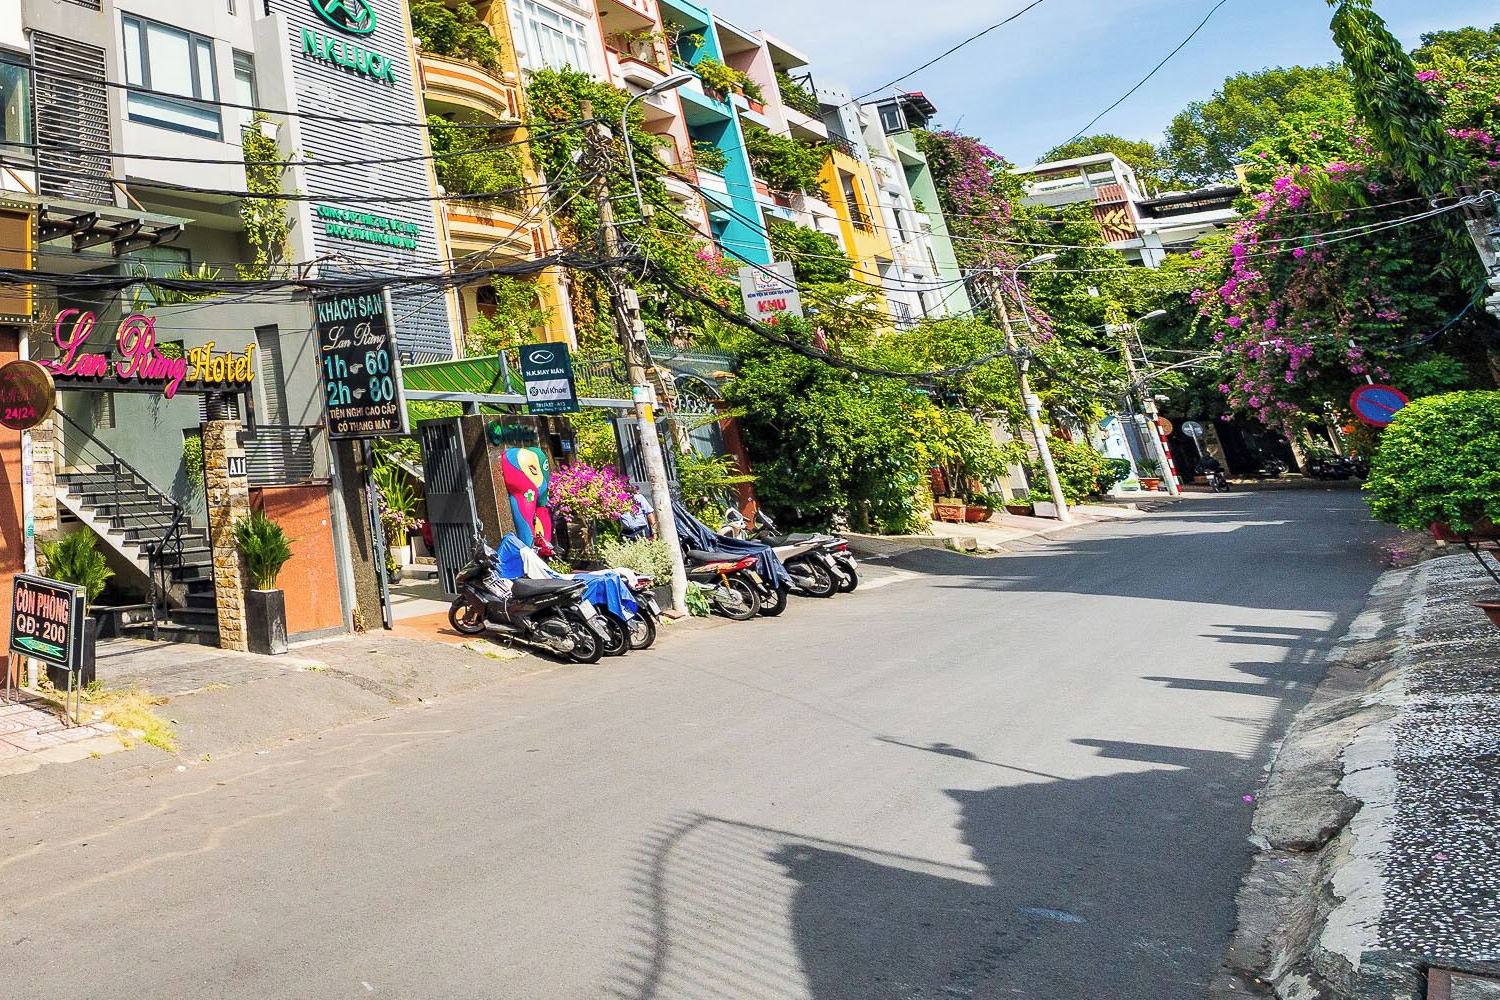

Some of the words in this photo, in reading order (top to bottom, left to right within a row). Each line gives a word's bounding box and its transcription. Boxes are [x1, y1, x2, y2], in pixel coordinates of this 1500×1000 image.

[301, 27, 396, 83] N.K.LUCK
[318, 296, 357, 323] KHÁCH
[358, 293, 383, 320] SẠN
[757, 298, 787, 312] KHU
[323, 326, 351, 351] Lan
[354, 322, 386, 350] Rừng
[40, 308, 107, 377] Lan
[117, 314, 187, 399] Rừng
[187, 341, 256, 383] Hotel
[324, 354, 348, 379] 1h
[365, 349, 389, 375] 60
[327, 381, 351, 405] 2h
[369, 375, 394, 402] 80
[4, 406, 36, 420] 24/24
[330, 407, 346, 420] TIỆN
[365, 405, 380, 416] CAO
[381, 401, 397, 415] CẤP
[338, 420, 348, 432] CÓ
[349, 421, 374, 432] THANG
[374, 417, 391, 430] MÁY
[230, 457, 247, 475] A11
[16, 583, 36, 614] CÒN
[37, 589, 69, 624] PHÒNG
[16, 613, 40, 636] QĐ:
[43, 621, 66, 643] 200
